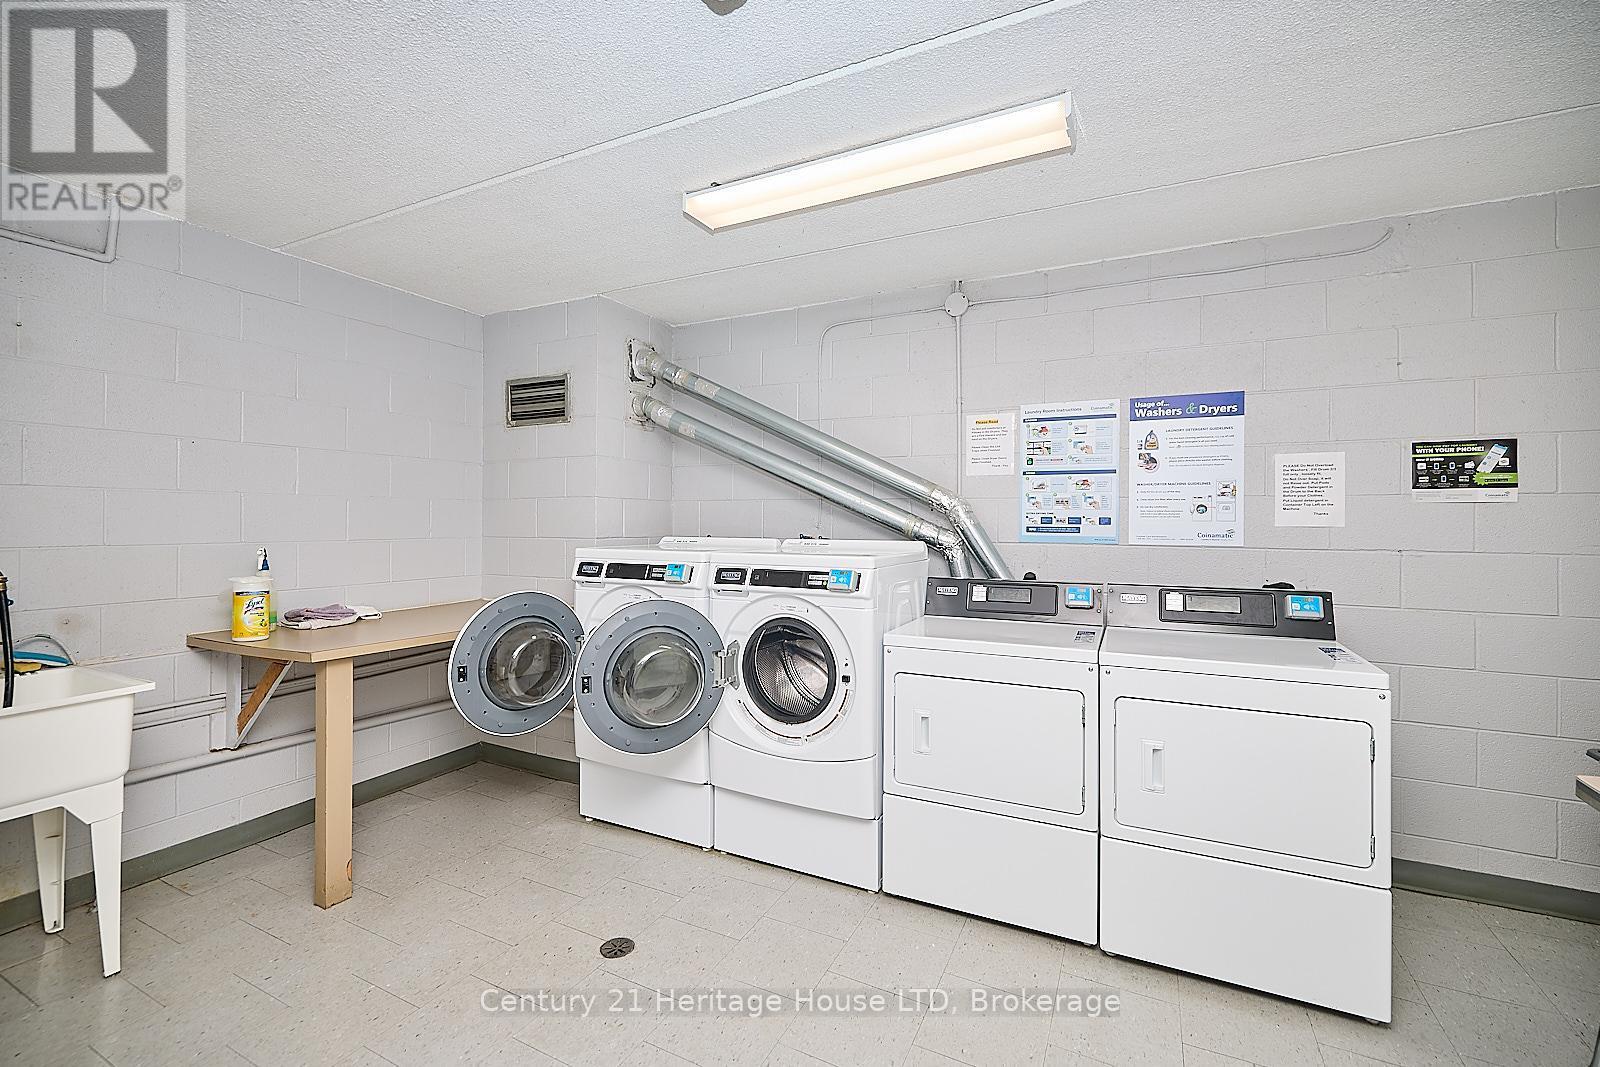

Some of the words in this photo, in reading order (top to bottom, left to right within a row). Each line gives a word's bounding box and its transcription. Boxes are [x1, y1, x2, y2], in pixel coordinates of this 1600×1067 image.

[1135, 407, 1182, 418] Washers
[1186, 402, 1197, 414] &
[1199, 404, 1238, 416] Dryers
[245, 597, 265, 609] Lysol
